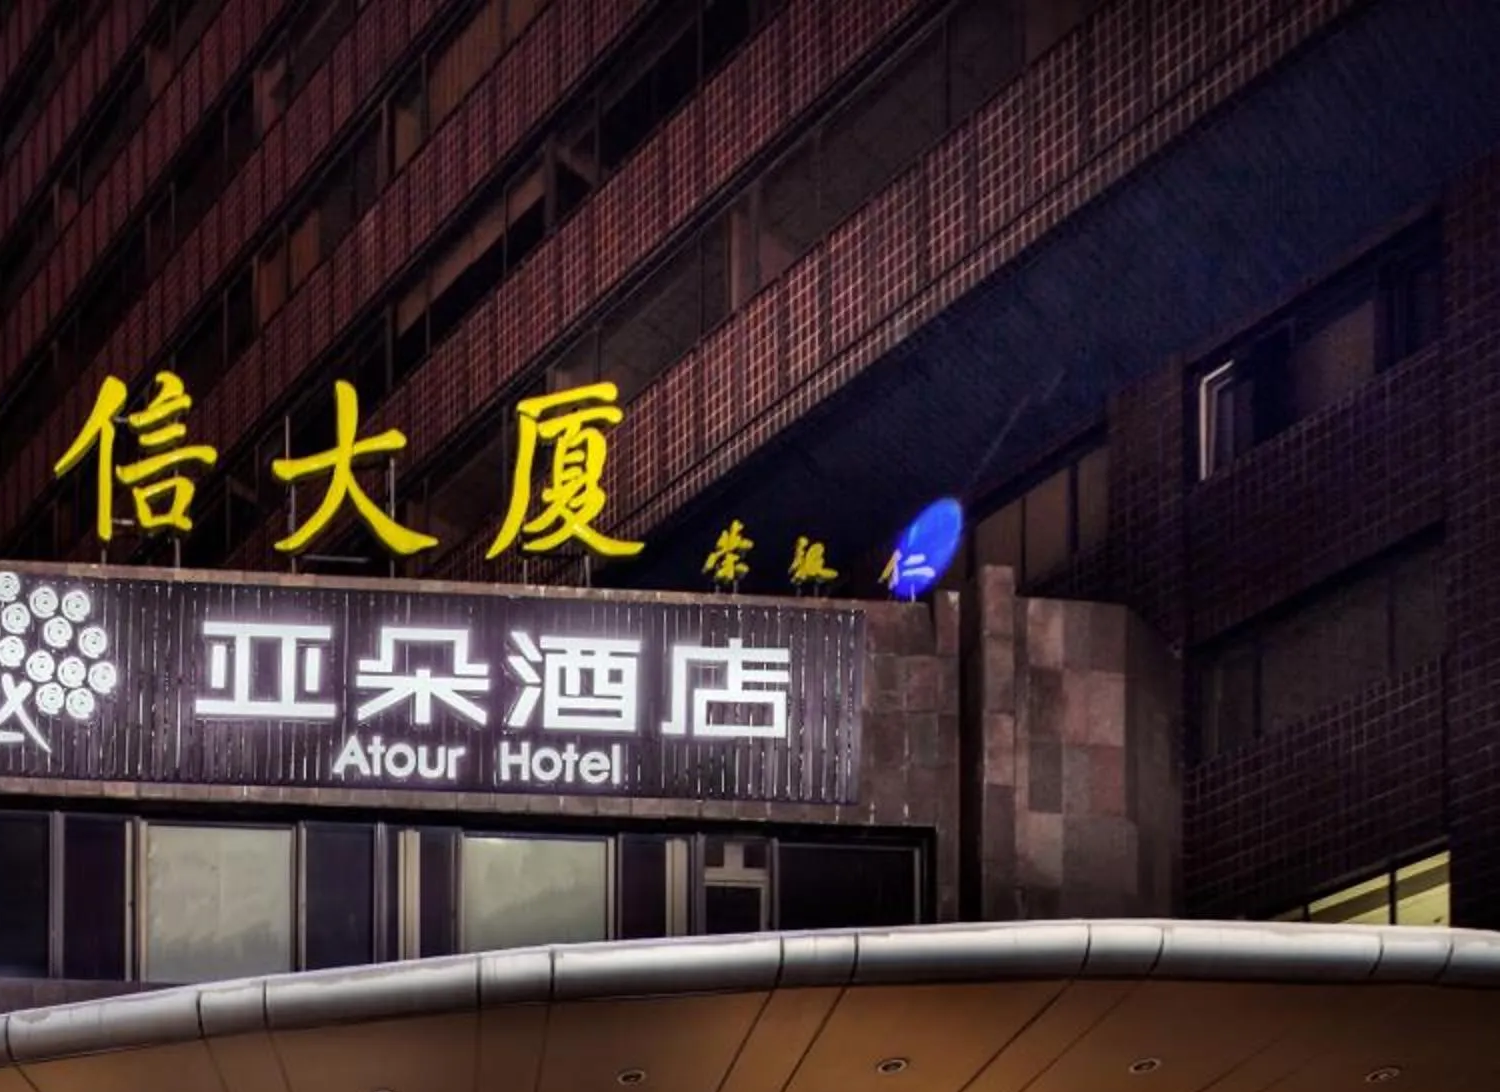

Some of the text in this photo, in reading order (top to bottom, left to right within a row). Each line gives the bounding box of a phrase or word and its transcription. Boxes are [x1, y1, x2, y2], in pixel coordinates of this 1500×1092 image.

[194, 618, 793, 742] 亚朵酒店
[332, 735, 622, 785] Atour Hotel
